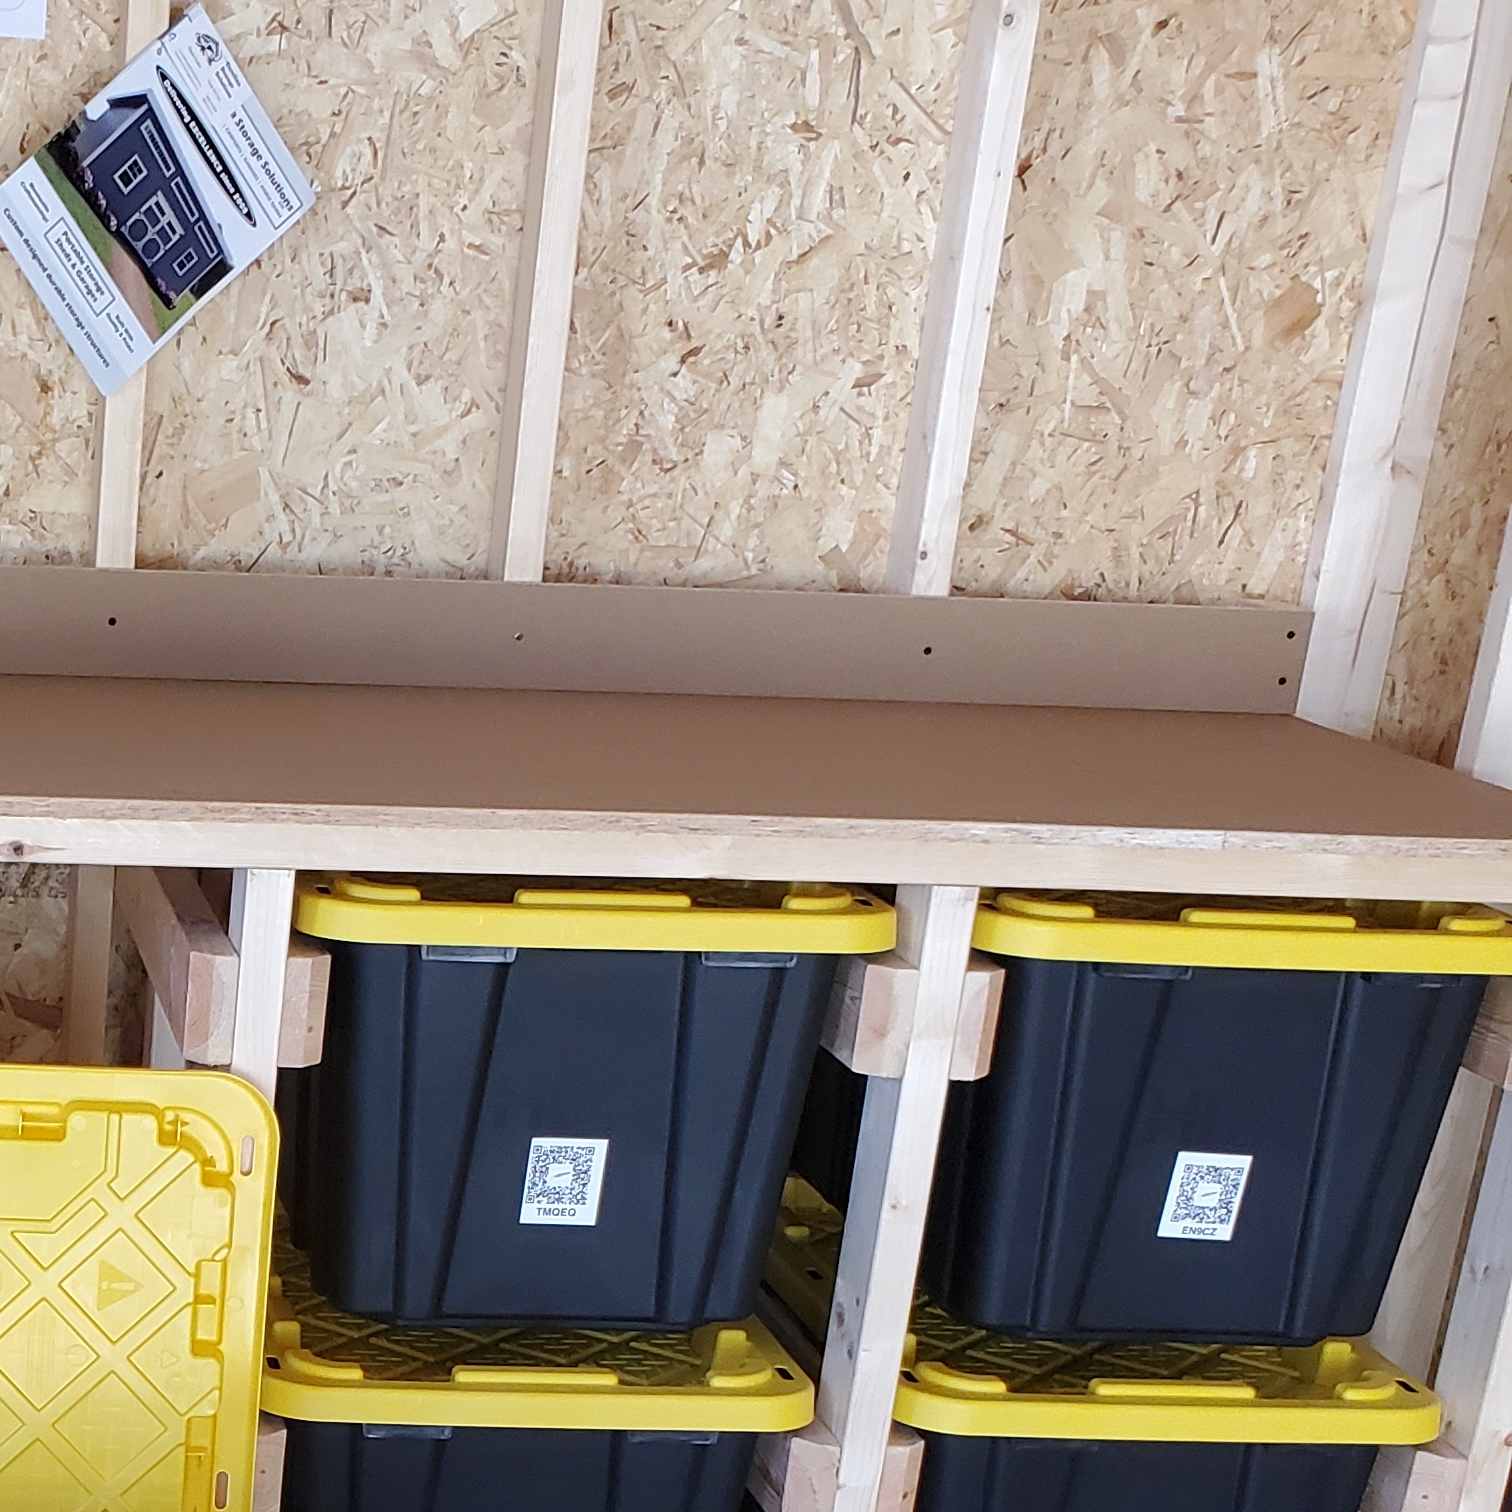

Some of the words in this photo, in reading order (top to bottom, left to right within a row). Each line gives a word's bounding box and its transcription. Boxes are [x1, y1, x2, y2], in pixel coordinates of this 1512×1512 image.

[161, 79, 192, 122] Delivering
[188, 121, 223, 172] EXCELLENCE
[232, 118, 265, 162] Storage
[260, 161, 295, 211] Solutions
[3, 207, 24, 238] Custom
[21, 237, 47, 273] designed
[45, 272, 67, 302] durable
[64, 302, 85, 331] storage
[84, 331, 109, 368] structures
[54, 238, 72, 262] Sheds
[69, 261, 79, 271] &
[74, 270, 98, 303] Garages
[61, 230, 86, 265] Portable
[82, 265, 105, 296] Storage
[536, 1208, 576, 1217] TMQEQ
[1182, 1226, 1217, 1236] EN9CZ
